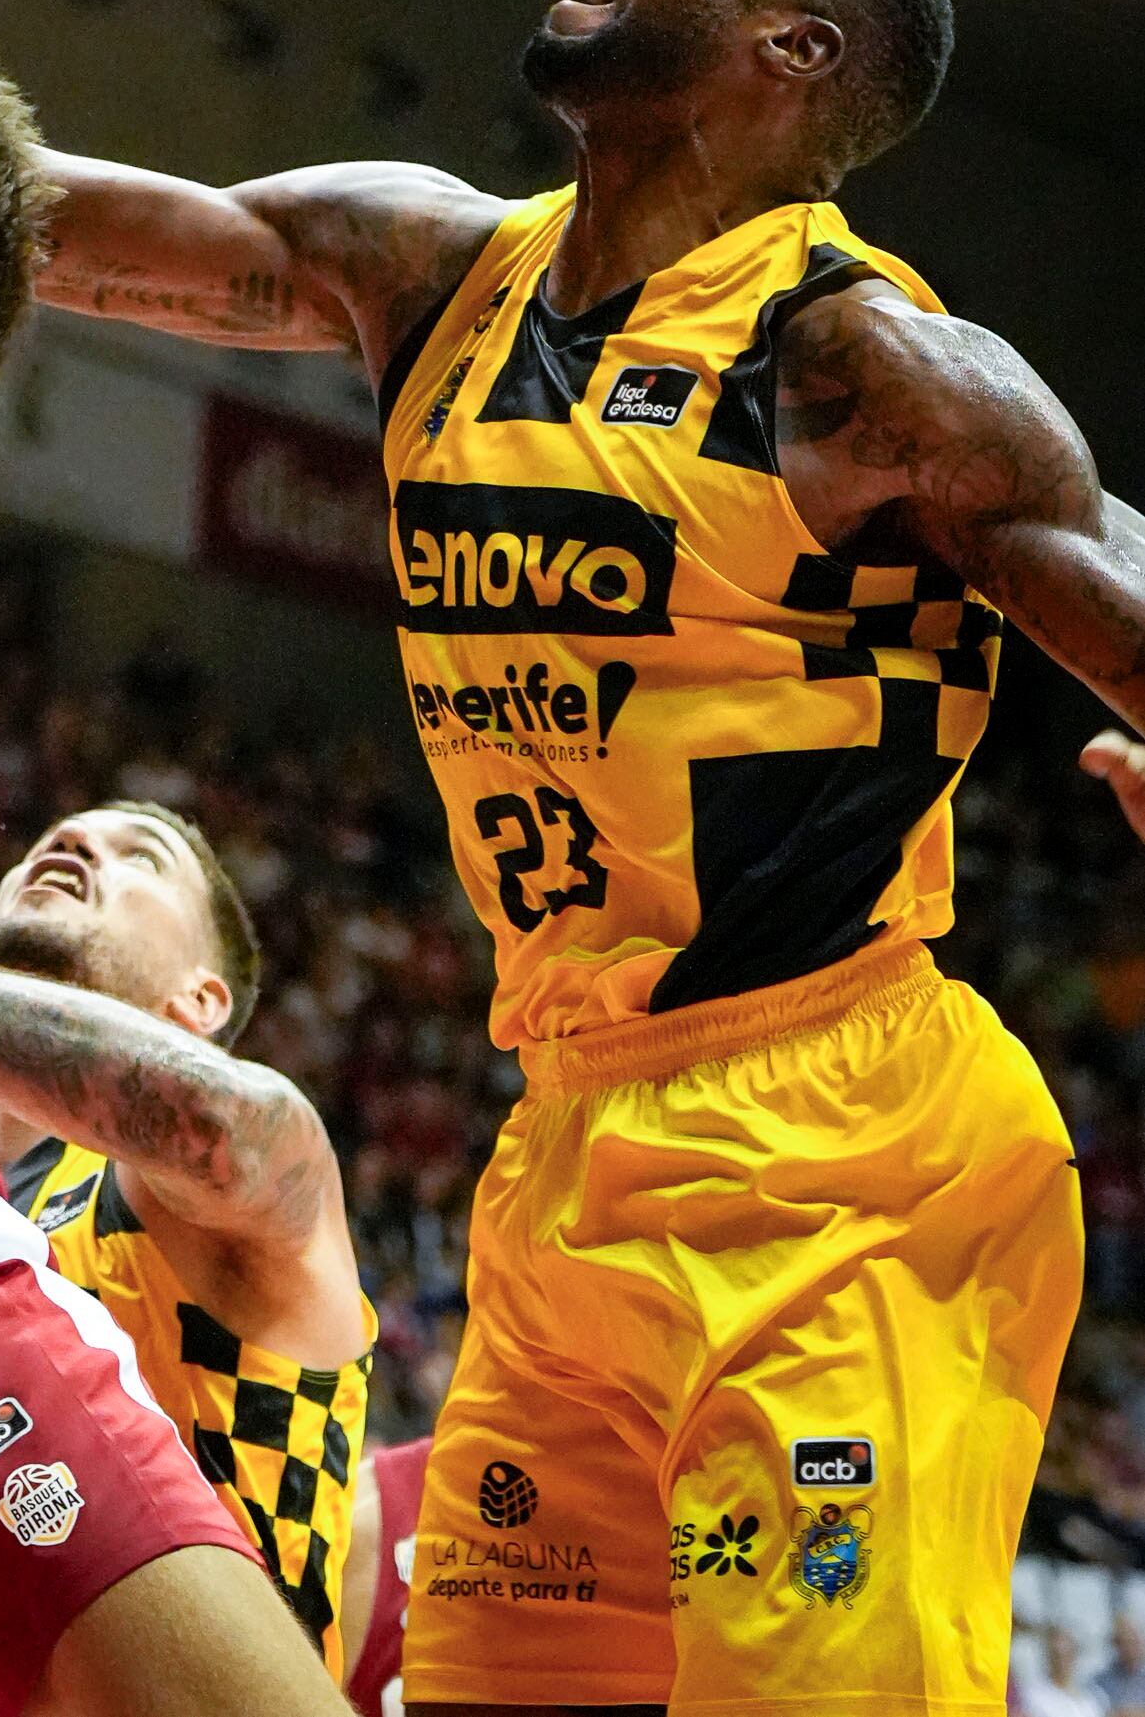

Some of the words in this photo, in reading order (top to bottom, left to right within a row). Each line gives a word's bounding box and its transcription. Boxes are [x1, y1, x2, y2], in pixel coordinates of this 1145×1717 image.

[616, 384, 648, 402] liga
[608, 400, 677, 421] endesa
[474, 786, 609, 933] 23
[800, 1458, 856, 1481] acb
[17, 1490, 81, 1543] GIRONA
[432, 1540, 457, 1566] LA
[466, 1540, 598, 1572] LAGUNA
[427, 1573, 505, 1602] deporte
[511, 1581, 568, 1602] para
[576, 1578, 598, 1602] ti
